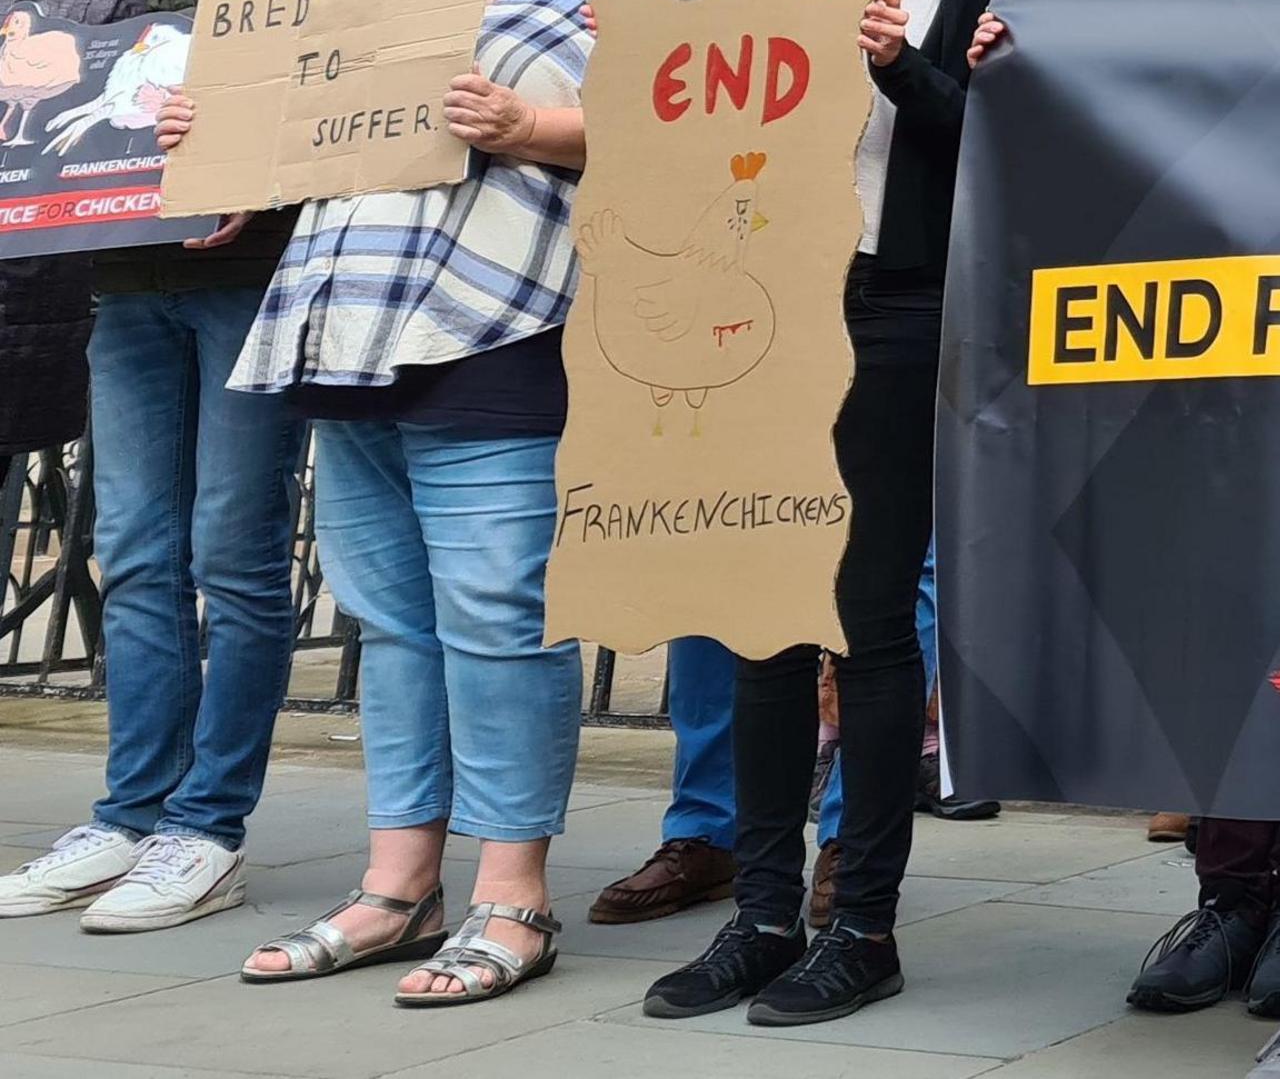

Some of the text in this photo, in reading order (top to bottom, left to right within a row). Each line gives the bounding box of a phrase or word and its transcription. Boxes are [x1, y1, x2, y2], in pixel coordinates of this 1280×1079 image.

[297, 48, 341, 86] TO
[652, 34, 811, 125] END
[312, 103, 438, 147] SUFFER.
[1052, 279, 1223, 364] END
[556, 483, 848, 547] FRANKENCHICKENS
